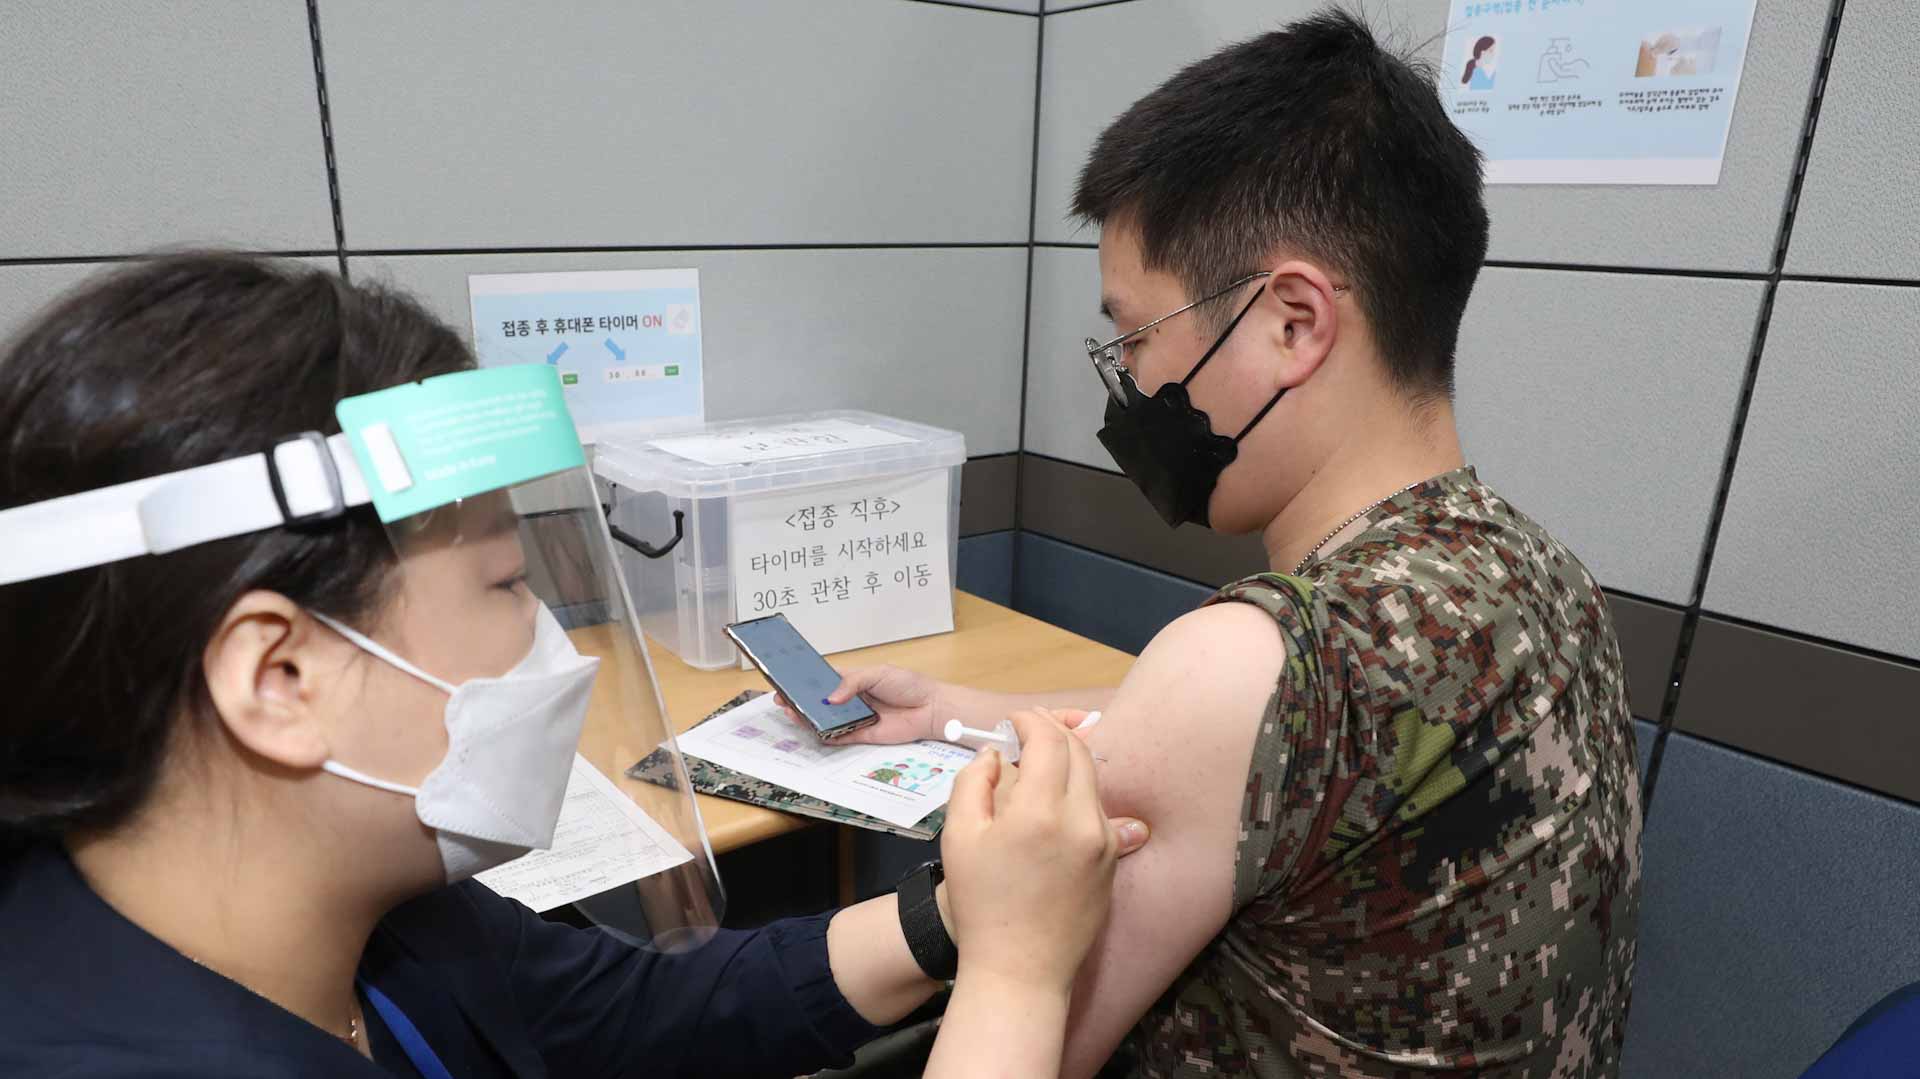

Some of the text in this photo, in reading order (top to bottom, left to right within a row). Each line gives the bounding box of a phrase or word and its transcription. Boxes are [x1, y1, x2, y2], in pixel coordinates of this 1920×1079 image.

[502, 315, 662, 337] 접종 후 휴대폰 타이머 ON
[785, 497, 900, 531] <접종 직후>
[751, 531, 927, 575] 타이머를 시작하세요
[753, 563, 932, 611] 30초 관찰 후 이동
